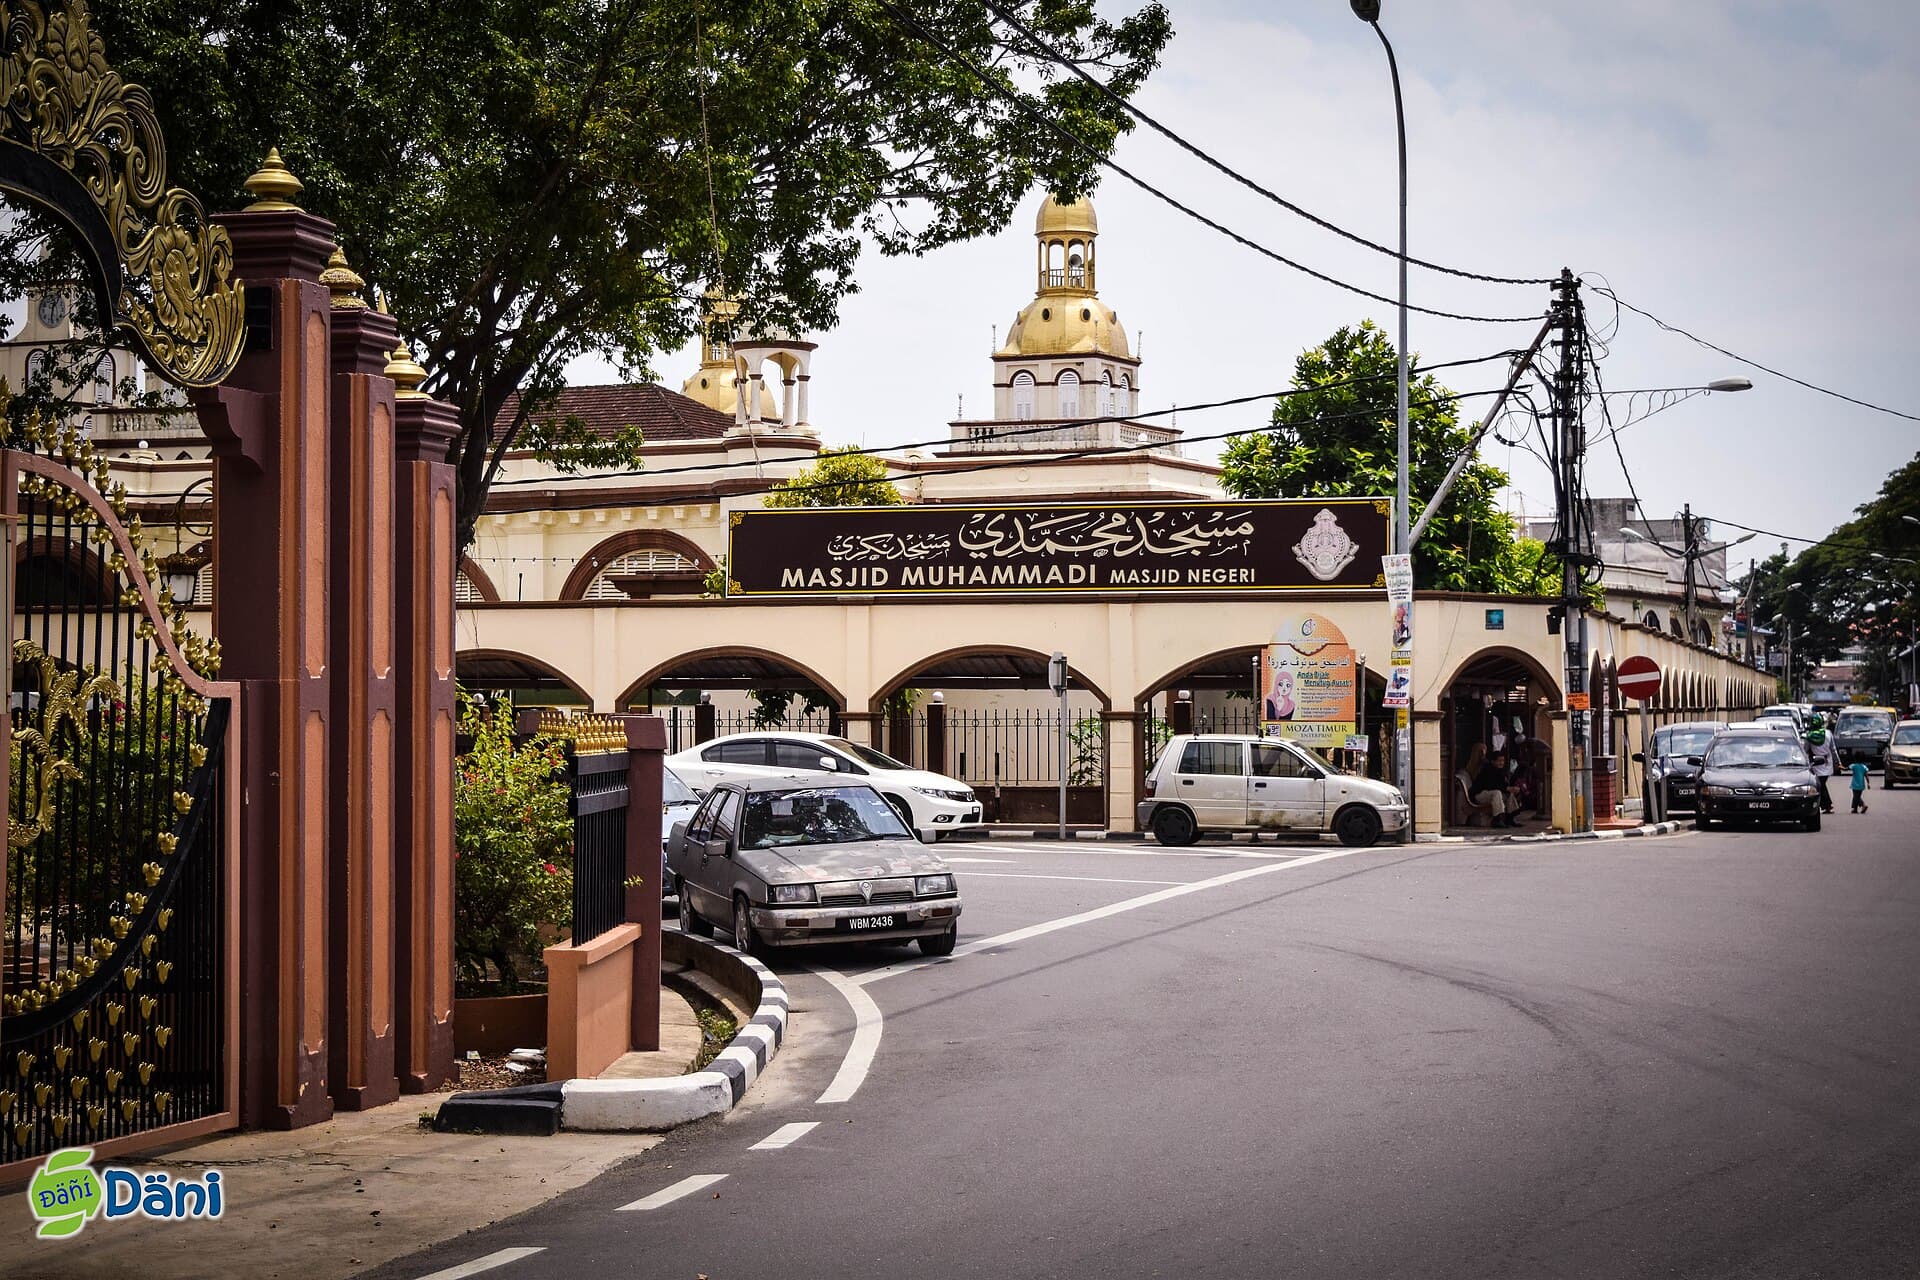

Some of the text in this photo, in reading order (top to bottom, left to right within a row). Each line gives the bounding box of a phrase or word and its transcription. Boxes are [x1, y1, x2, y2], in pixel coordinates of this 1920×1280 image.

[780, 564, 1255, 588] MASJID MUHAMMADI MASJID NEGERI
[1286, 724, 1314, 733] MOZA
[1316, 724, 1347, 733] TIMUR
[849, 916, 893, 929] WBM 2436
